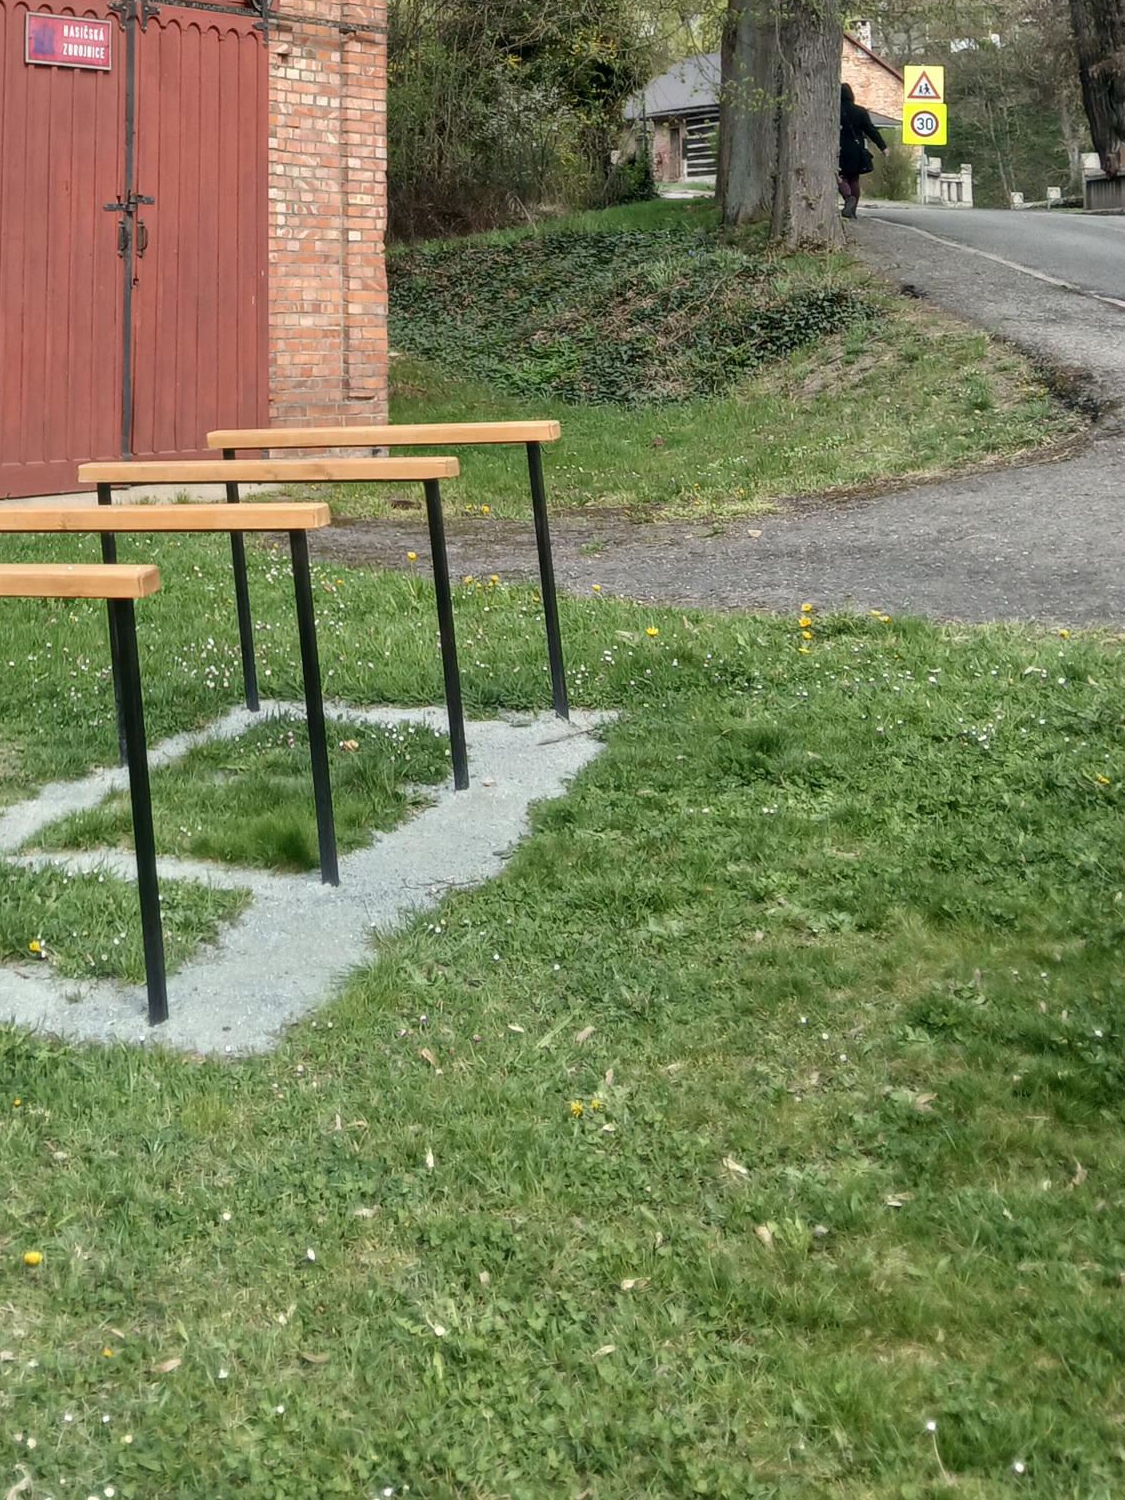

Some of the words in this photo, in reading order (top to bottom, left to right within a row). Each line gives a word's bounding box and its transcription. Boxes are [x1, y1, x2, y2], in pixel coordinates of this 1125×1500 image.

[63, 25, 105, 41] HASIČSKÁ
[62, 43, 106, 59] ZBROJNICE
[916, 117, 934, 131] 30
